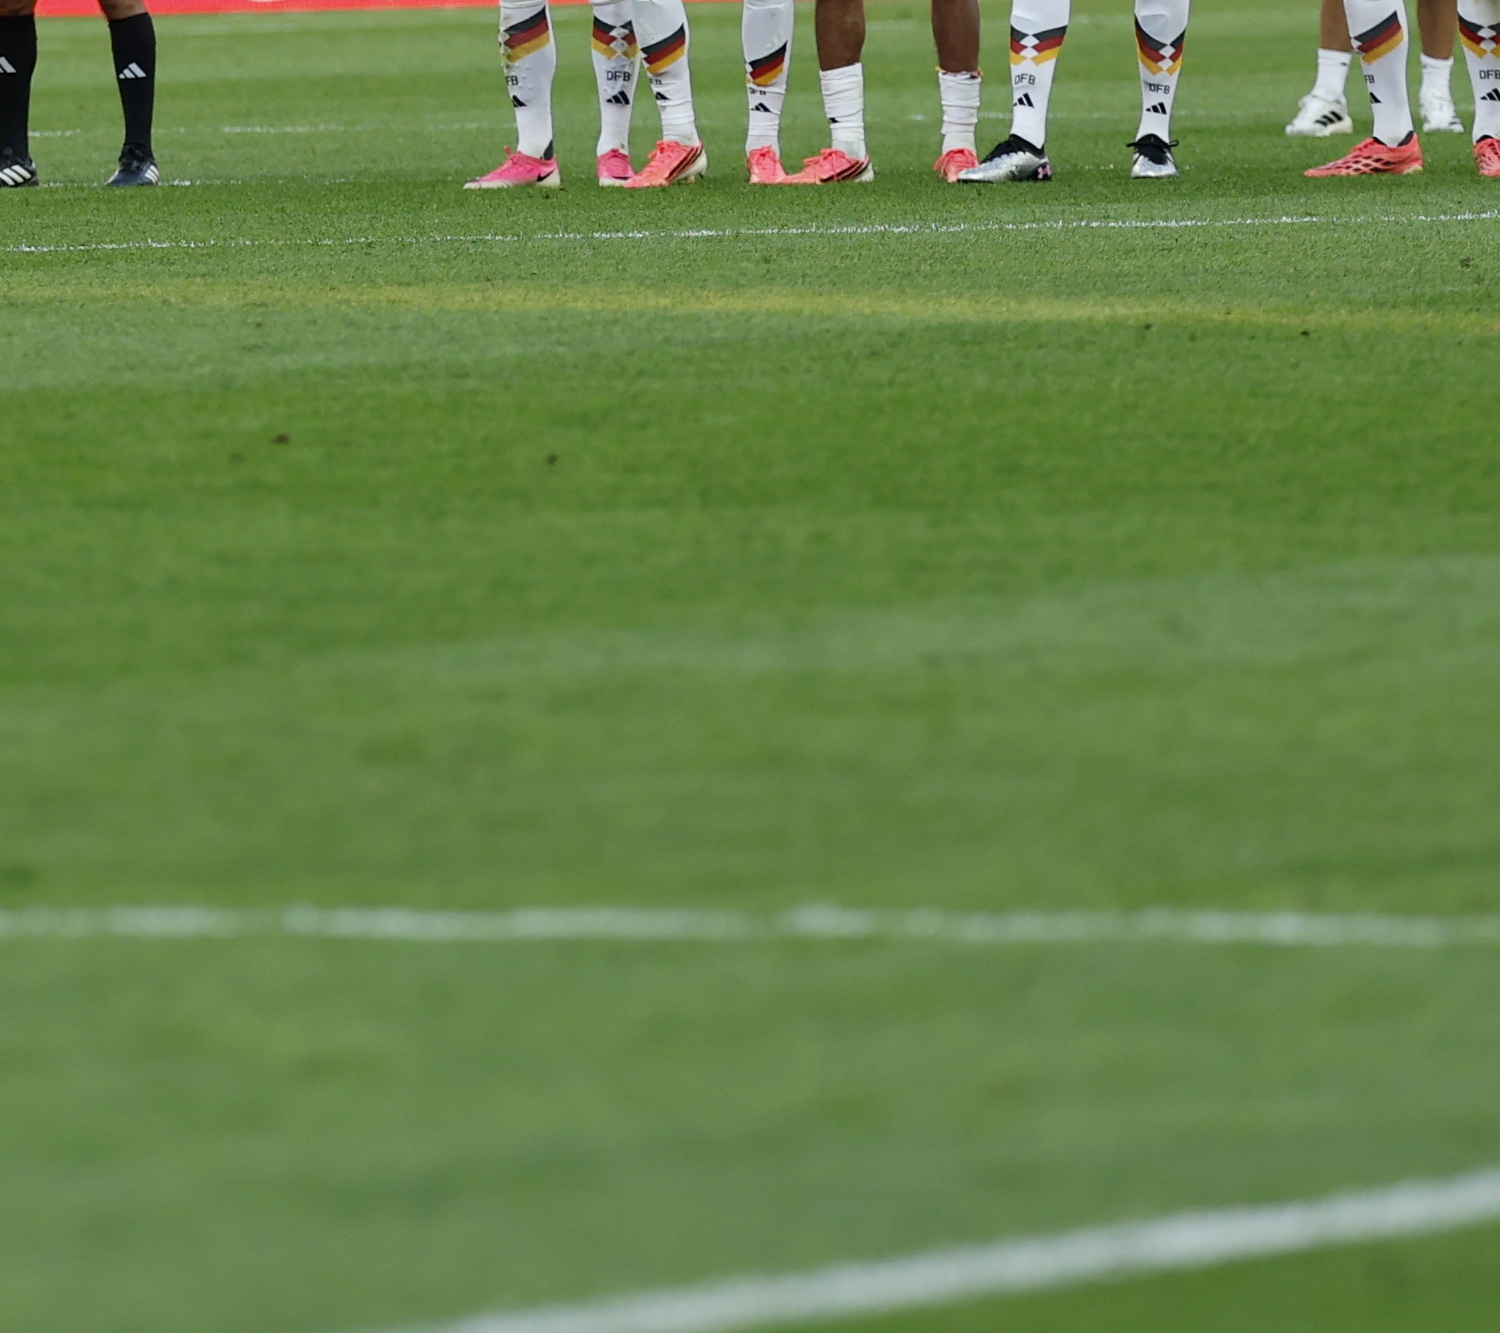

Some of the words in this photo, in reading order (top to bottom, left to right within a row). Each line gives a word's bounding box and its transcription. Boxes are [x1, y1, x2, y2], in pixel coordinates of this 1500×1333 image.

[505, 75, 519, 86] FB
[606, 69, 631, 82] DFB
[1014, 73, 1036, 85] DFB
[1364, 74, 1375, 84] FB
